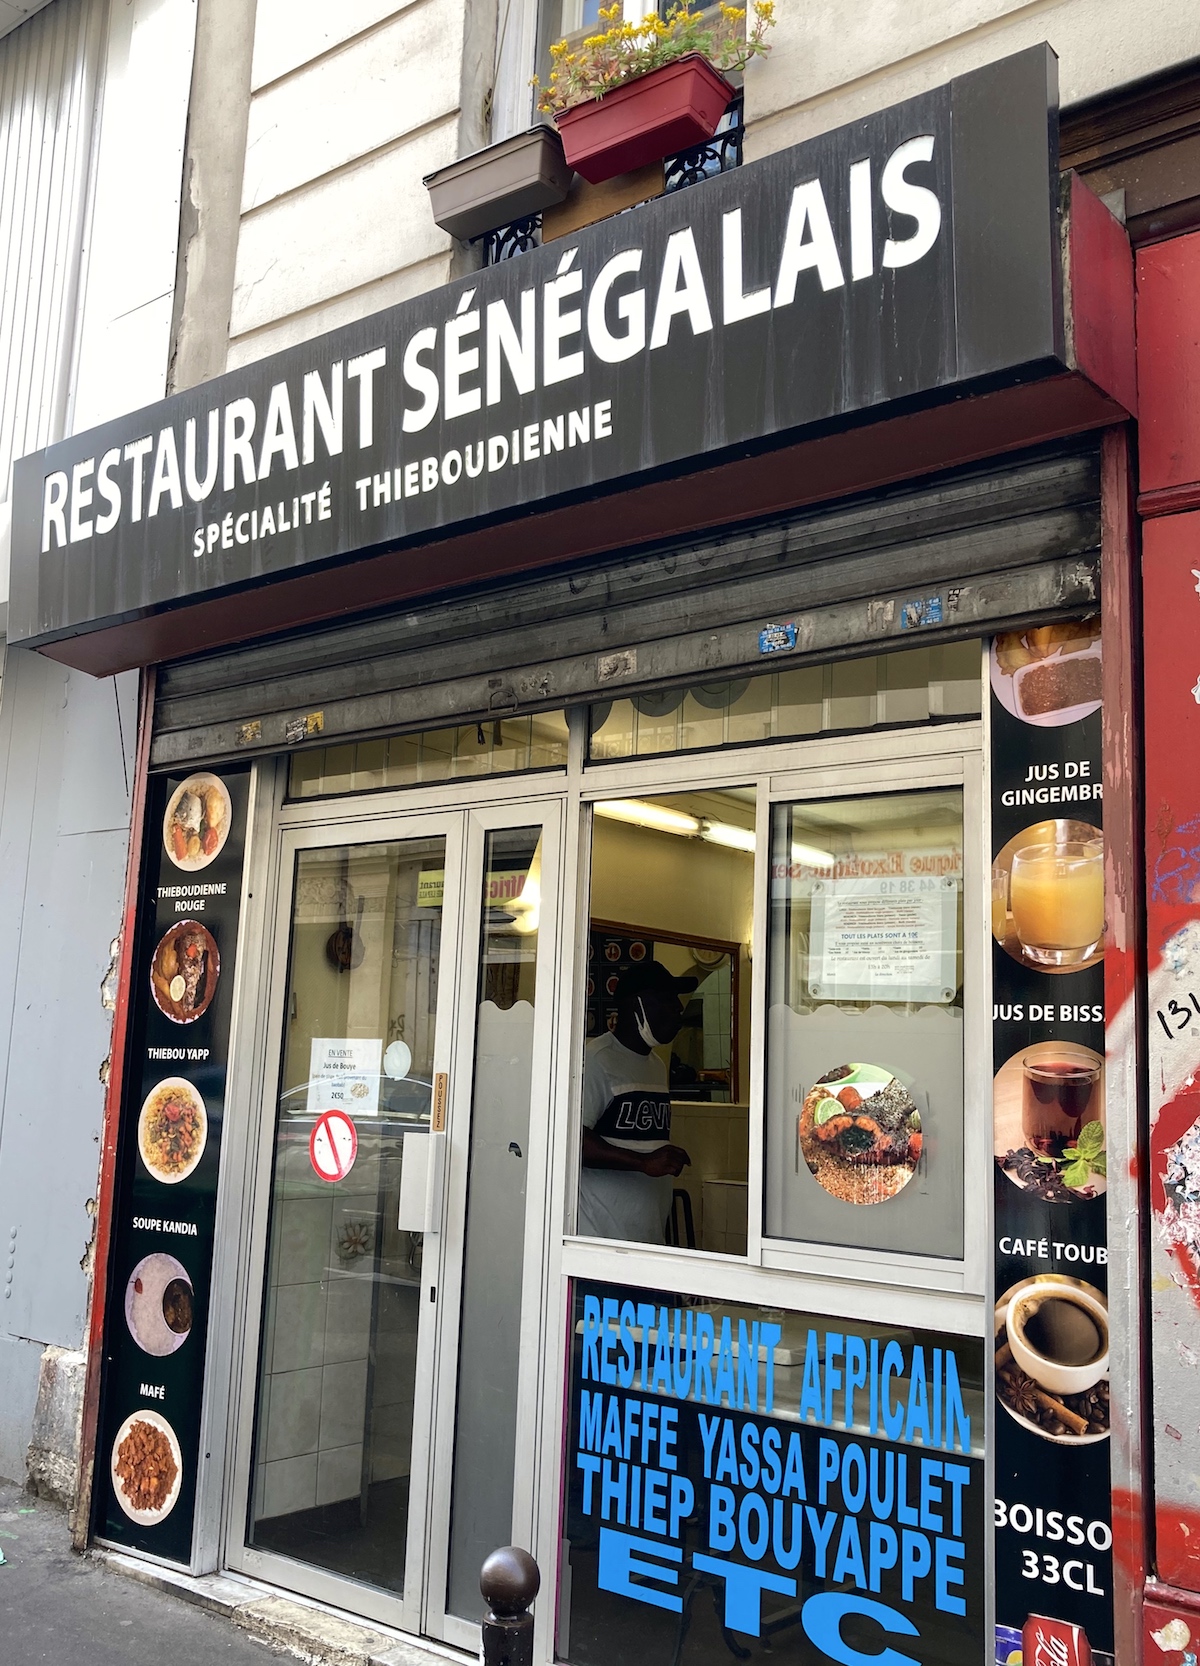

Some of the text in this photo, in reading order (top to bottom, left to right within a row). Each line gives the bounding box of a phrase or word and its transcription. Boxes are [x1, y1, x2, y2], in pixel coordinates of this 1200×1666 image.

[41, 135, 943, 554] RESTAURANT SÉNÉGALAIS
[193, 399, 613, 558] SPÉCIALITÉ THIEBOUDIENNE
[1024, 760, 1091, 783] JUS DE
[1001, 783, 1104, 807] GINGEMBR
[157, 883, 227, 898] THIEBOUDIENNE
[175, 900, 206, 912] ROUGE
[993, 1004, 1107, 1022] JUS DE BISS
[148, 1048, 210, 1060] THIEBOU YAPP
[336, 1049, 354, 1058] VENTE
[436, 1074, 444, 1128] POUSSEZ
[133, 1216, 198, 1236] SOUPE KANDIA
[999, 1237, 1108, 1265] CAFÉ TOUB
[582, 1294, 782, 1414] RESTAURANT
[140, 1383, 165, 1400] MAFÉ
[580, 1389, 971, 1537] MAFFE YASSA POULET
[576, 1452, 695, 1539] THIEP
[994, 1498, 1113, 1551] BOISSO
[1021, 1549, 1105, 1597] 33CL
[598, 1526, 923, 1666] ETC
